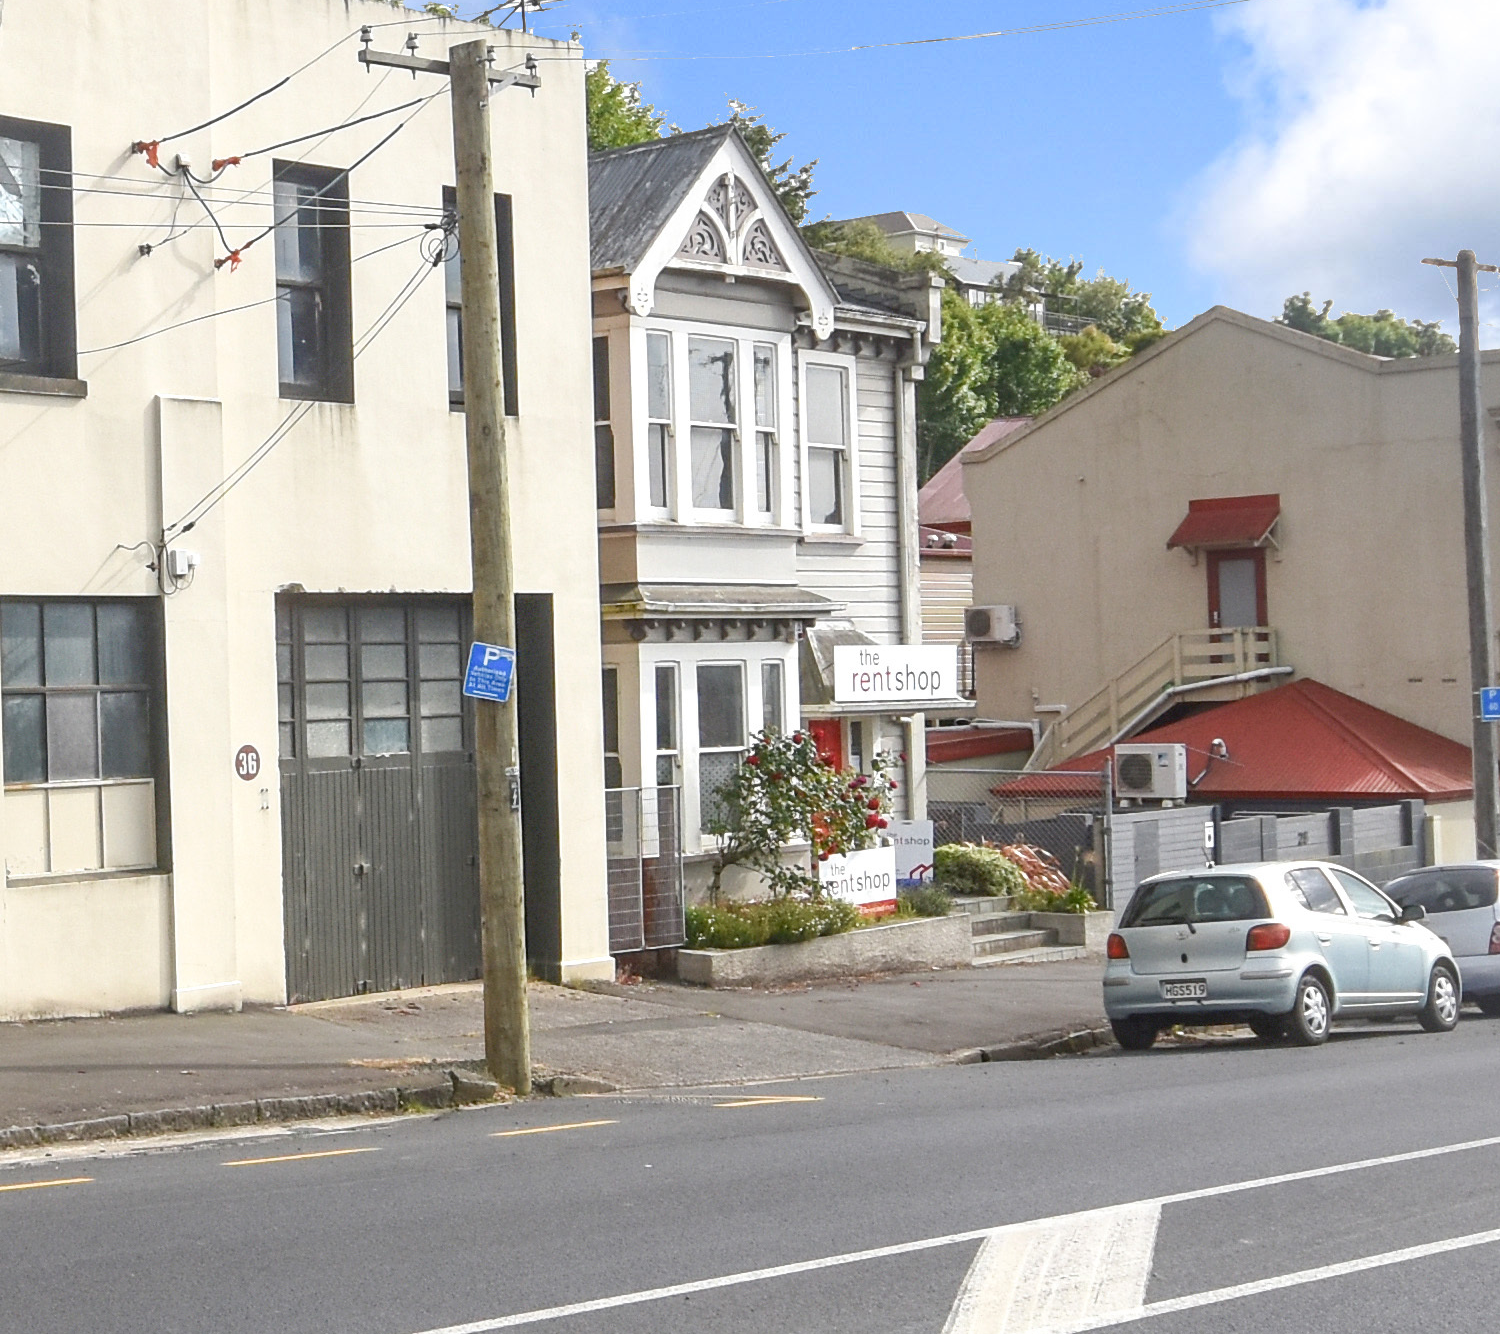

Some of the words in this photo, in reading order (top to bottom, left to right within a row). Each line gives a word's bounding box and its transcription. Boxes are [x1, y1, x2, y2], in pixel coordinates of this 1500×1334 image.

[484, 648, 500, 665] P
[860, 648, 880, 666] the
[239, 751, 257, 776] 36
[830, 863, 846, 877] the
[1165, 984, 1205, 996] HGS519
